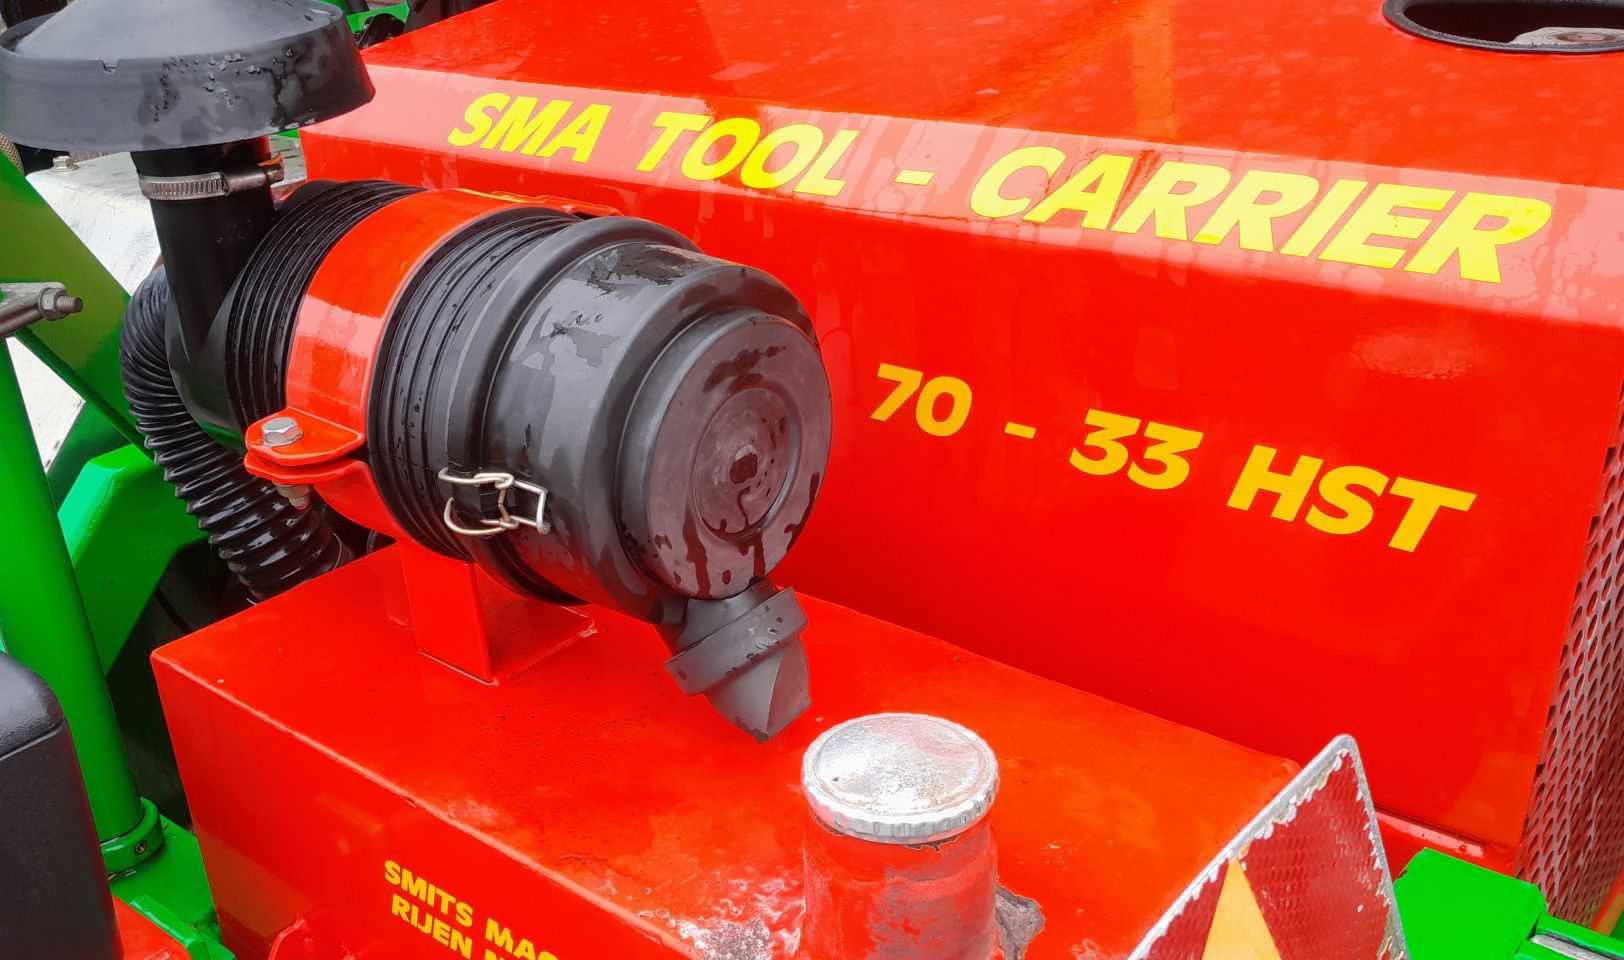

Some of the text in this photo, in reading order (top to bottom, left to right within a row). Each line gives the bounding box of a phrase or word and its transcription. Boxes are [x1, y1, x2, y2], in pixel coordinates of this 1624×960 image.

[447, 92, 1553, 284] SMA TOOL - CARRIER
[872, 363, 1476, 553] 70 - 33 HST
[384, 860, 474, 928] SMITS
[391, 894, 473, 960] RIJEN
